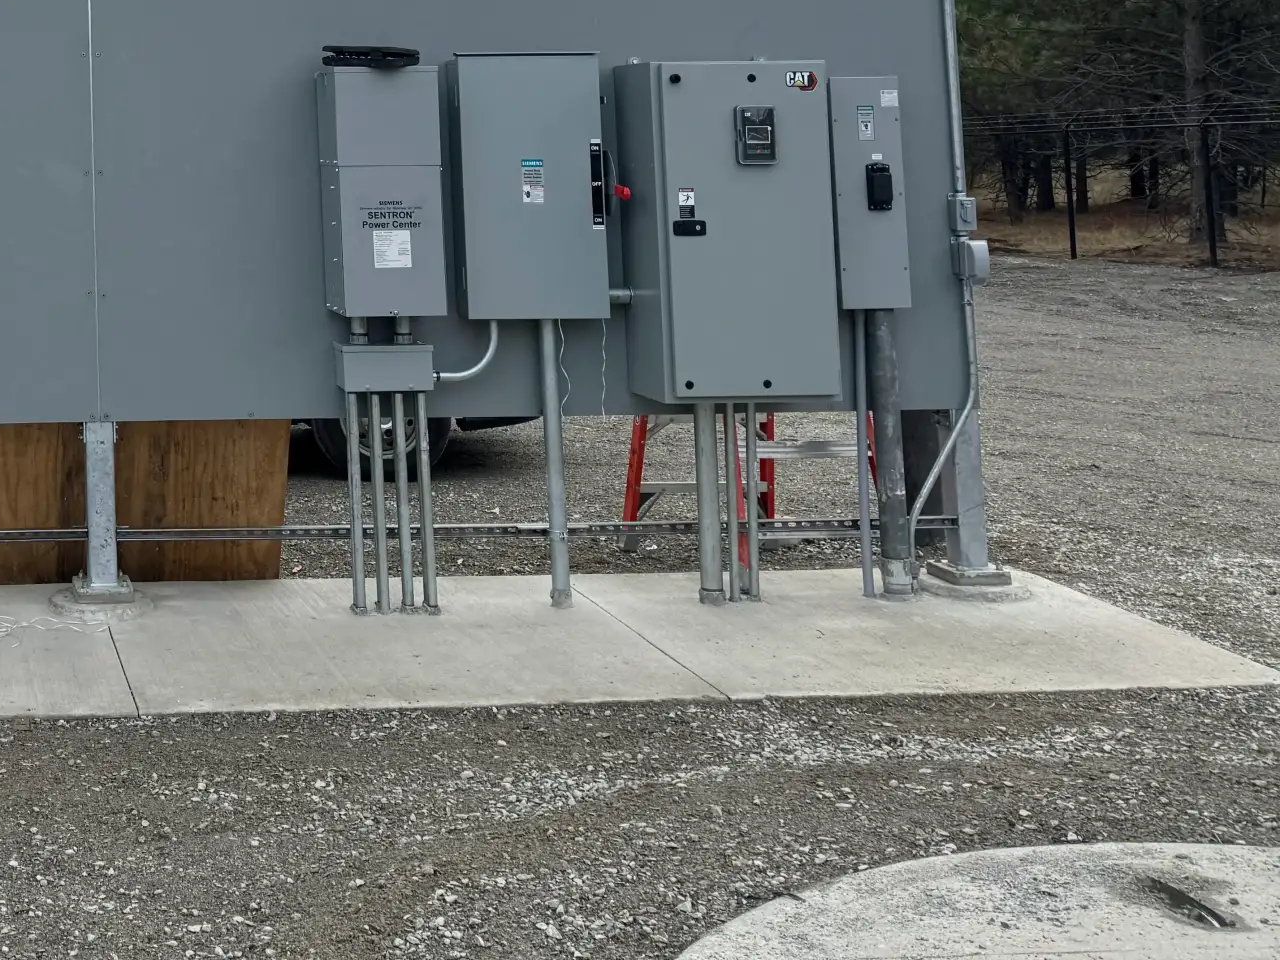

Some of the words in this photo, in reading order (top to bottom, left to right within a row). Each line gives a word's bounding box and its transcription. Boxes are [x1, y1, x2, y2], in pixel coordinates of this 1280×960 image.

[786, 72, 809, 86] CAT
[367, 211, 413, 220] SENTRON
[362, 221, 390, 229] Power
[392, 221, 422, 229] Center
